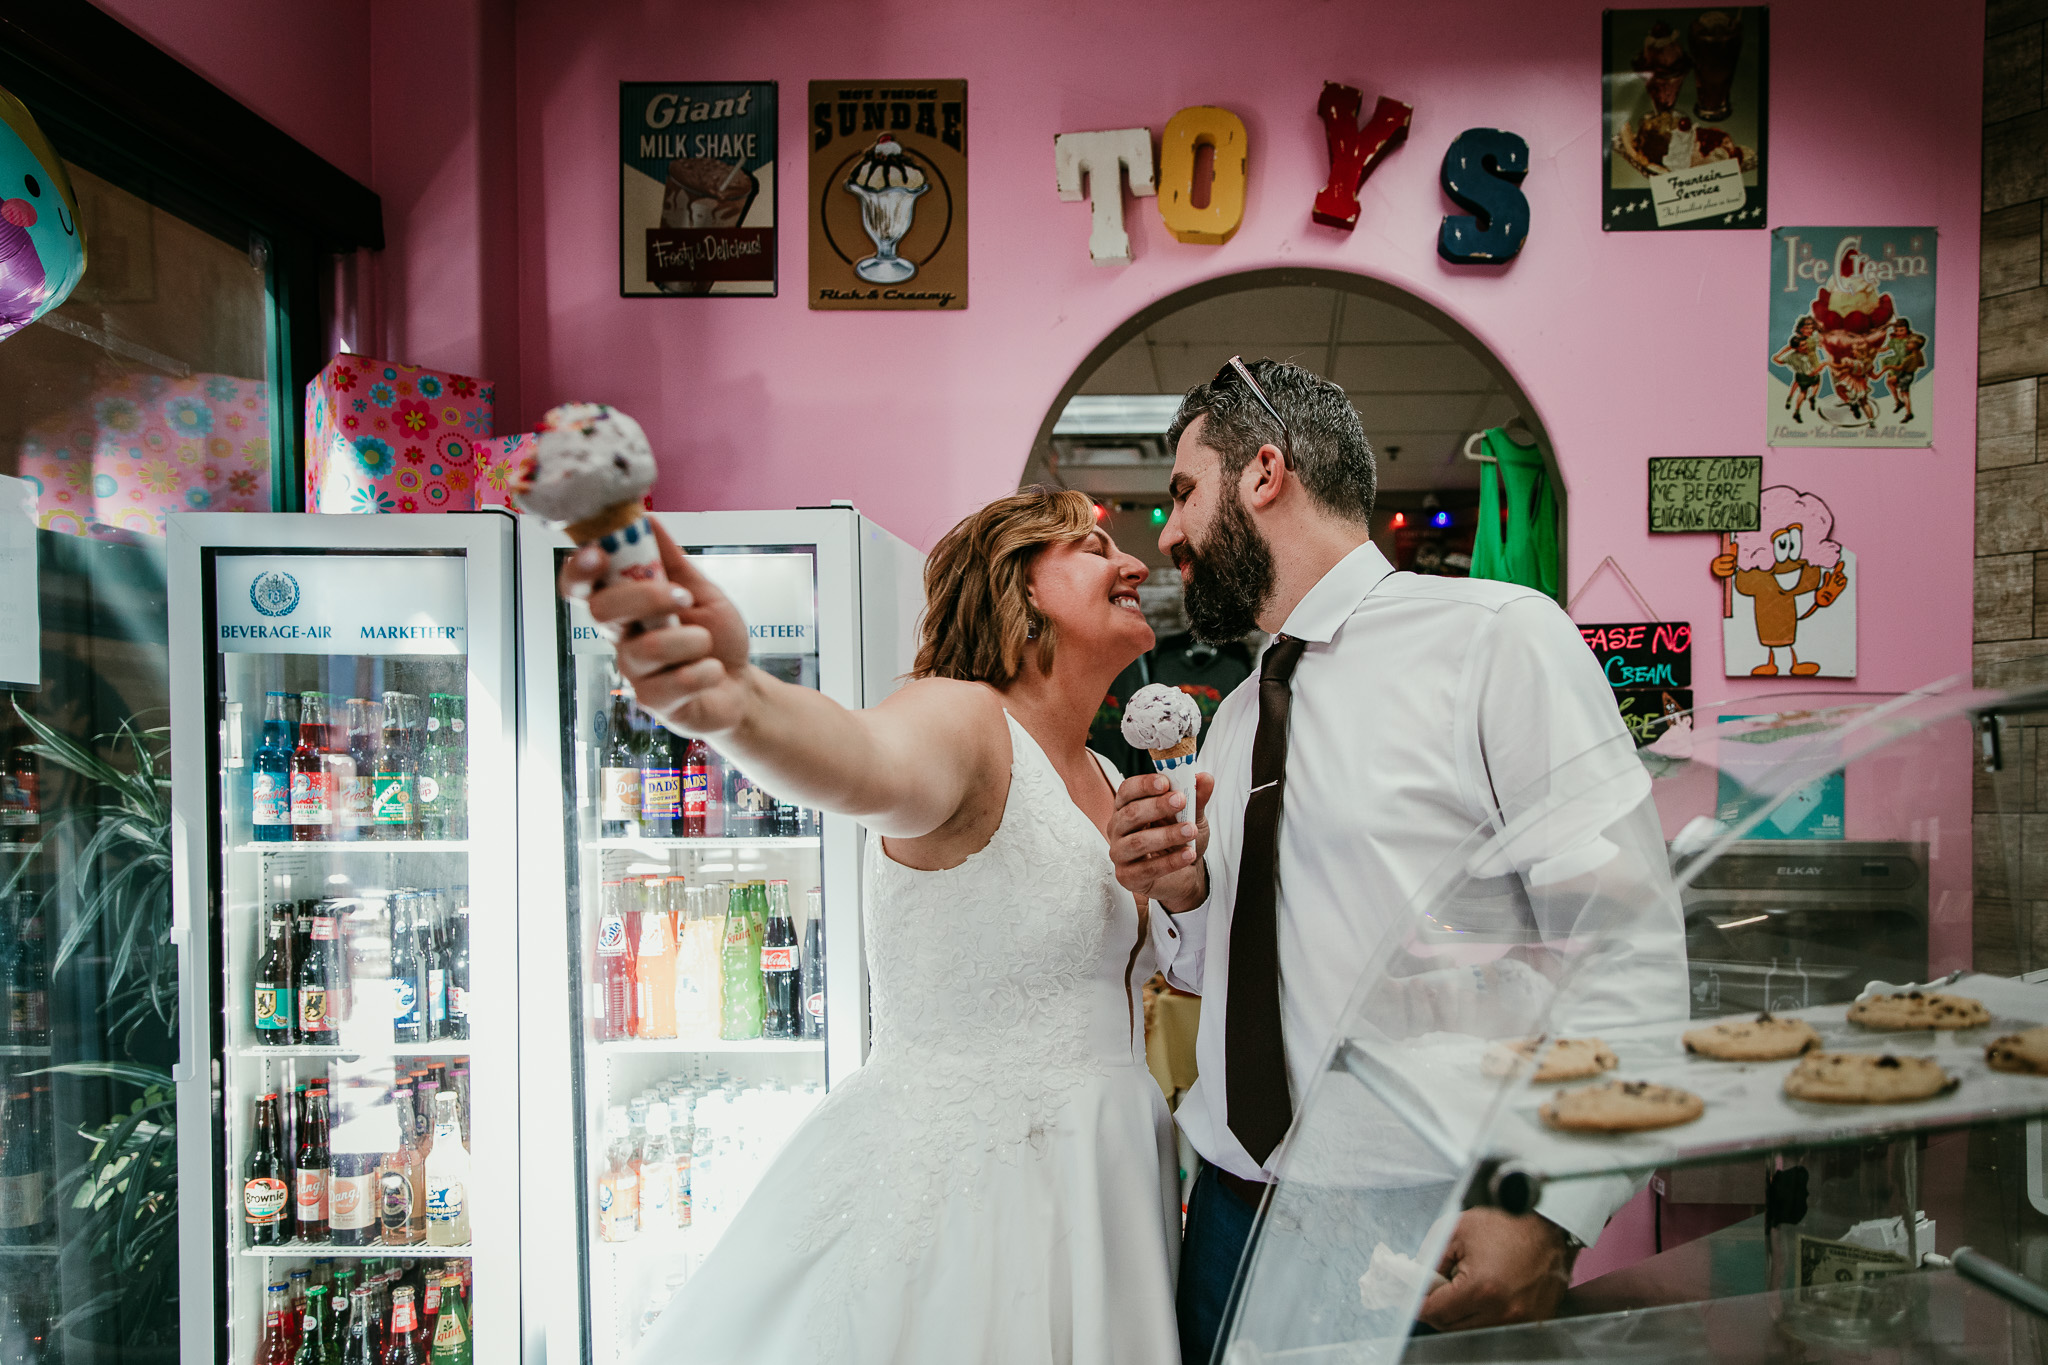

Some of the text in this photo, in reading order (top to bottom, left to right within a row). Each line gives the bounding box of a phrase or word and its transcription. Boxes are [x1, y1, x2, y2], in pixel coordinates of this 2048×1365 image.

[838, 89, 938, 99] HOT FUDGE
[645, 89, 752, 129] Giant
[814, 102, 961, 153] SUNDAE
[640, 134, 757, 158] MILK SHAKE
[1055, 80, 1530, 266] TOYS
[1667, 169, 1723, 190] Fountain
[1675, 184, 1720, 200] Service
[652, 240, 696, 270] Frosty
[1783, 235, 1928, 296] Ice Cream
[820, 288, 956, 307] Rich & Creamy
[1651, 458, 1760, 482] PLEASE ENJOY
[1652, 481, 1746, 502] ME BEFORE
[1652, 503, 1705, 529] ENTERING
[221, 625, 332, 638] BEVERAGE-AIR
[1580, 623, 1691, 654] EASE NO
[1604, 655, 1679, 687] CREAM
[648, 780, 678, 793] DAD'S
[683, 775, 707, 789] DAD'S
[1776, 866, 1825, 875] ELKAY
[727, 929, 751, 944] Squirt
[246, 1190, 285, 1204] Brownie
